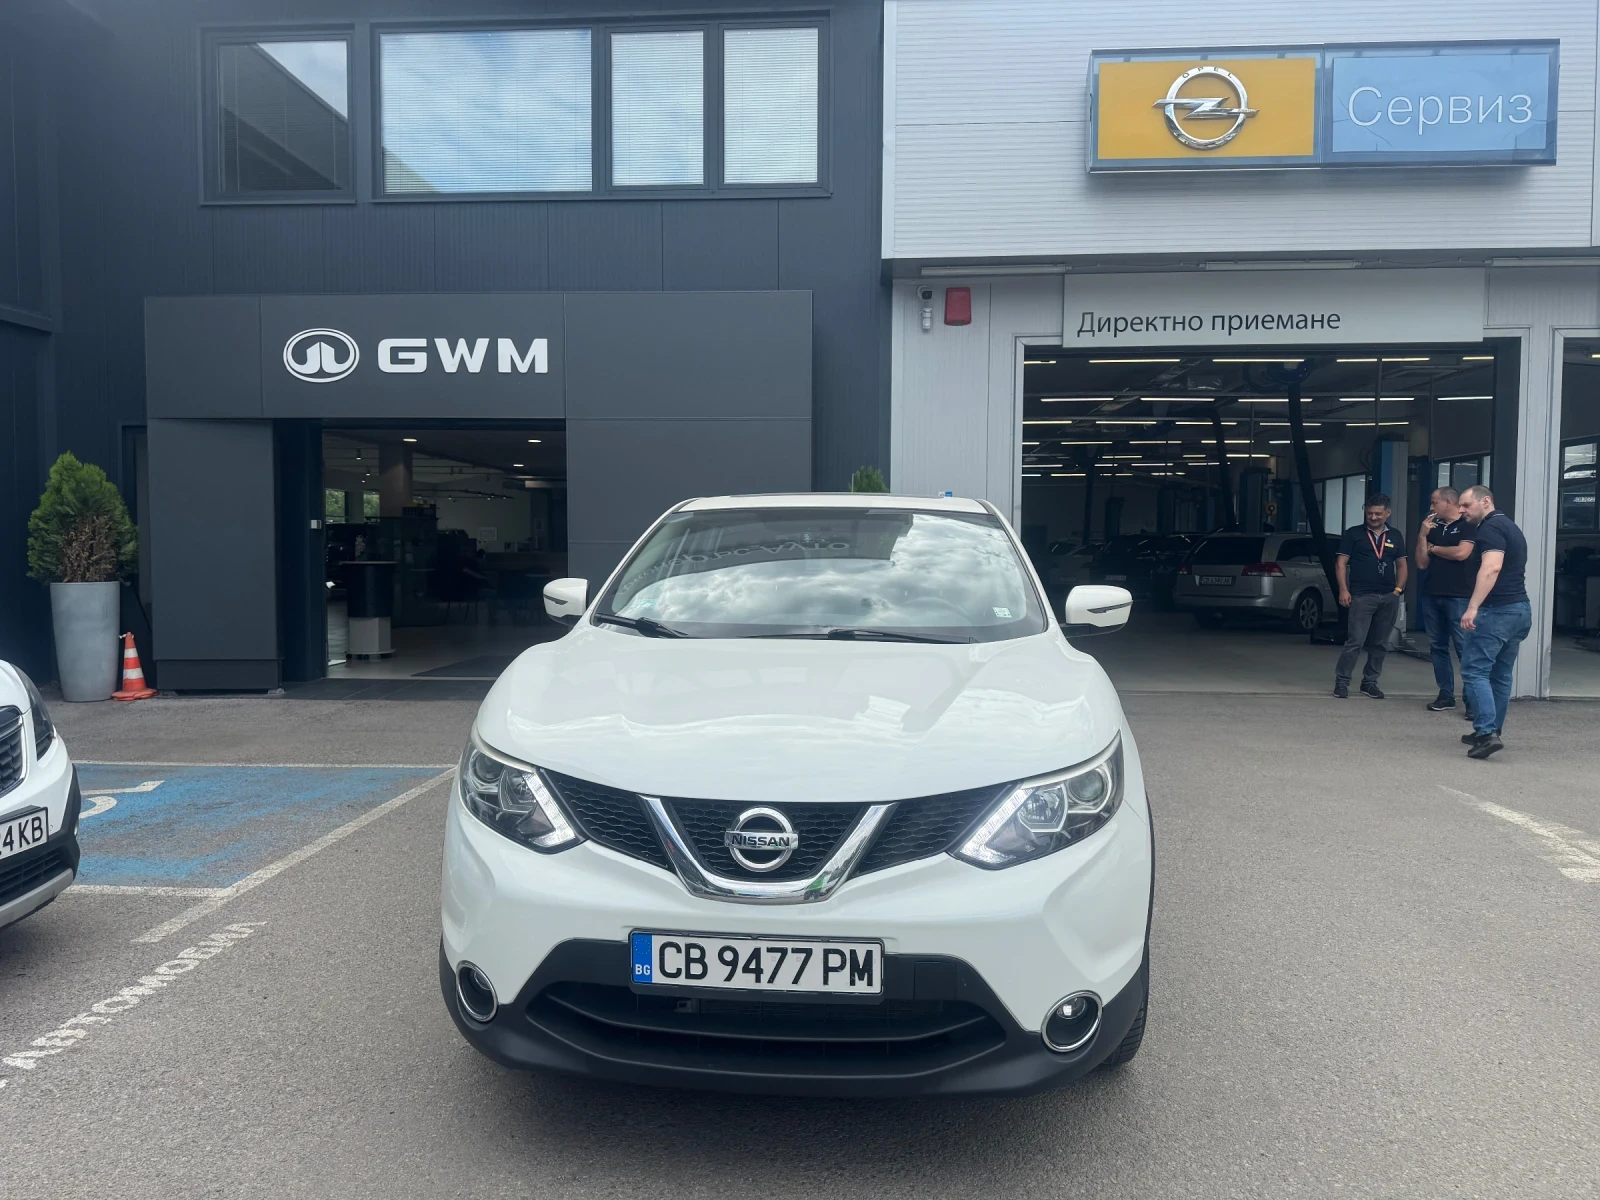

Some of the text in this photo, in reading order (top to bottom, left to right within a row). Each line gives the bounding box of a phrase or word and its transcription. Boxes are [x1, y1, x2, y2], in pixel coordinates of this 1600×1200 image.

[1181, 66, 1233, 79] OPEL
[1348, 86, 1533, 136] Сервиз
[1076, 311, 1341, 338] Директно приемане
[377, 337, 549, 374] GWM
[0, 816, 43, 855] 4 KB
[731, 833, 790, 847] NISSAN
[634, 963, 651, 976] BG
[659, 941, 874, 987] CB 9477 PM
